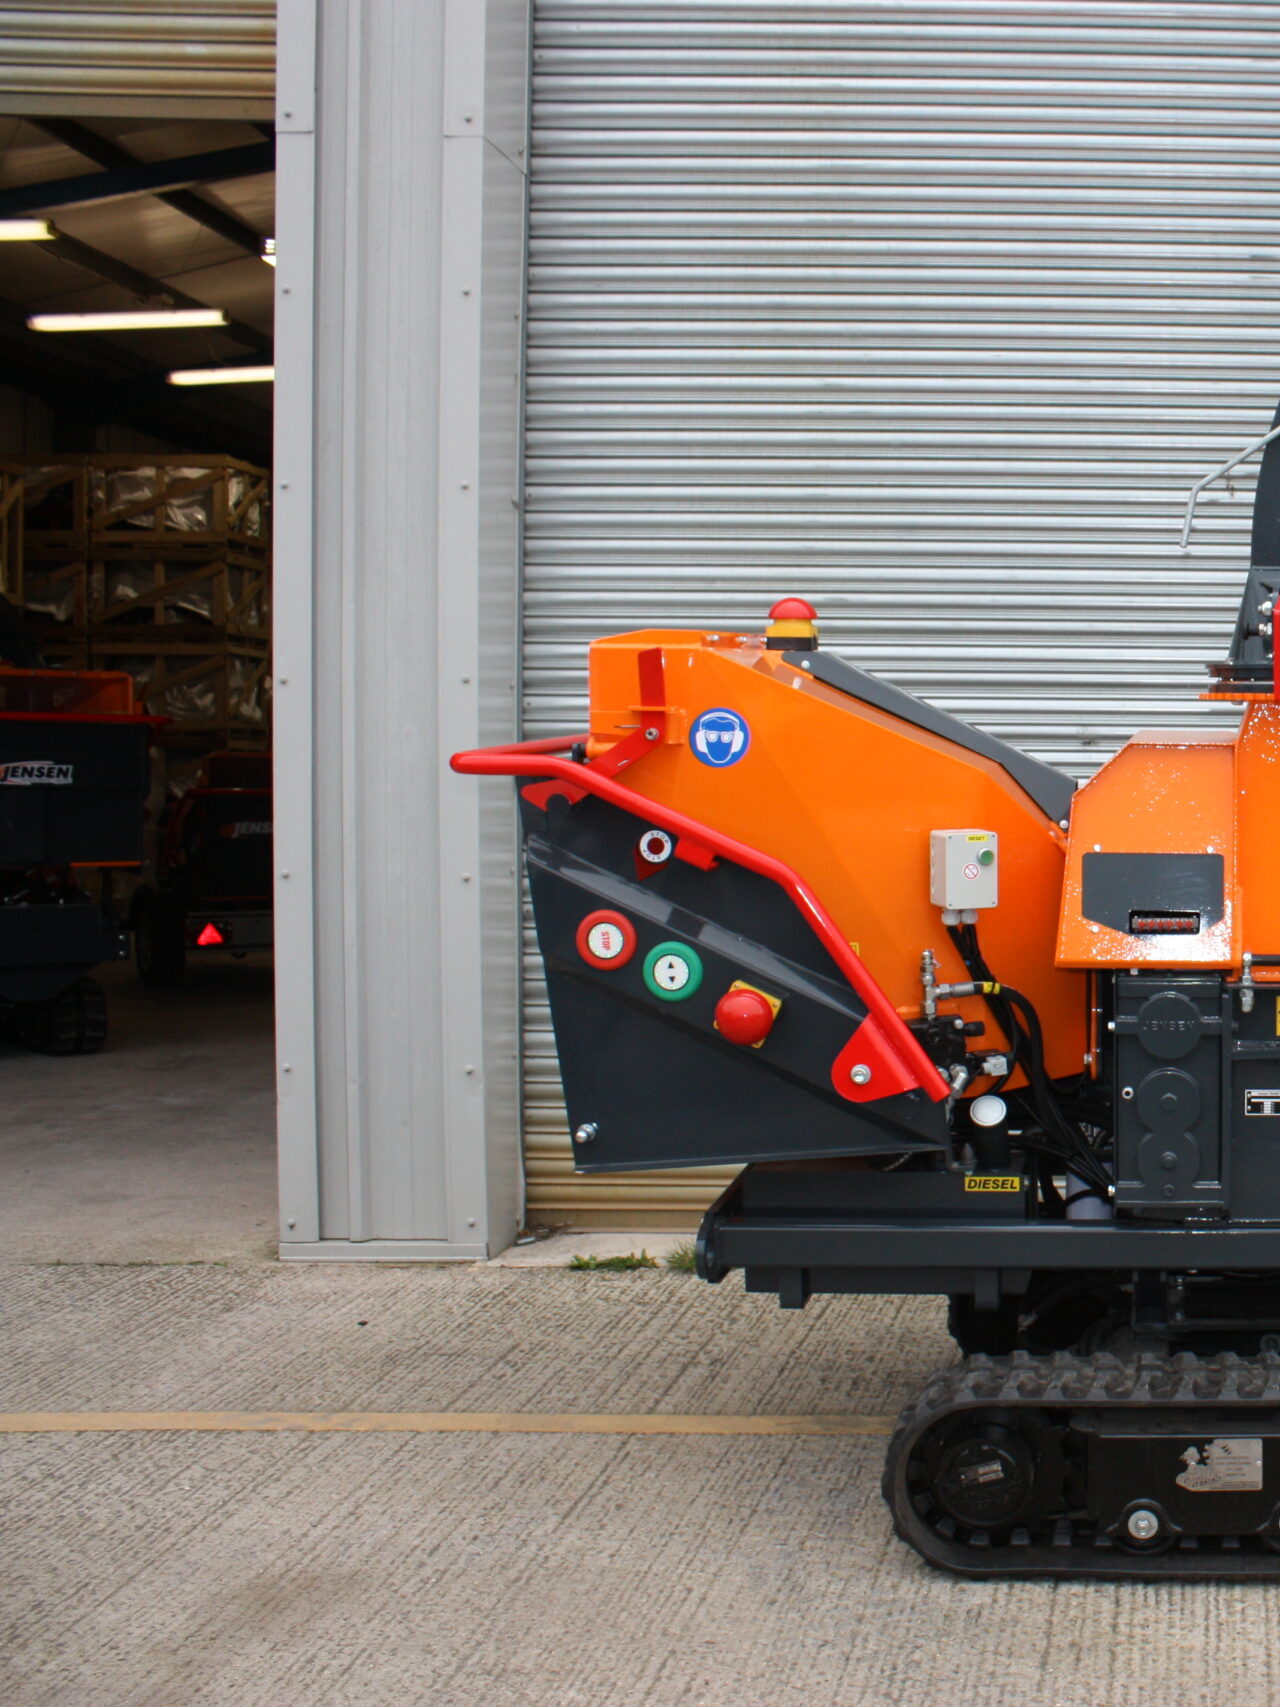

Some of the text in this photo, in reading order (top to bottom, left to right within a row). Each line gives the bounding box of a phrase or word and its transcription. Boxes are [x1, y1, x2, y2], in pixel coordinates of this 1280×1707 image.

[0, 766, 70, 781] JENSEN
[231, 821, 273, 839] JENS
[650, 831, 669, 844] STOP
[601, 931, 611, 951] STOP
[1143, 1020, 1195, 1031] JENSEN
[967, 1178, 1017, 1190] DIESEL
